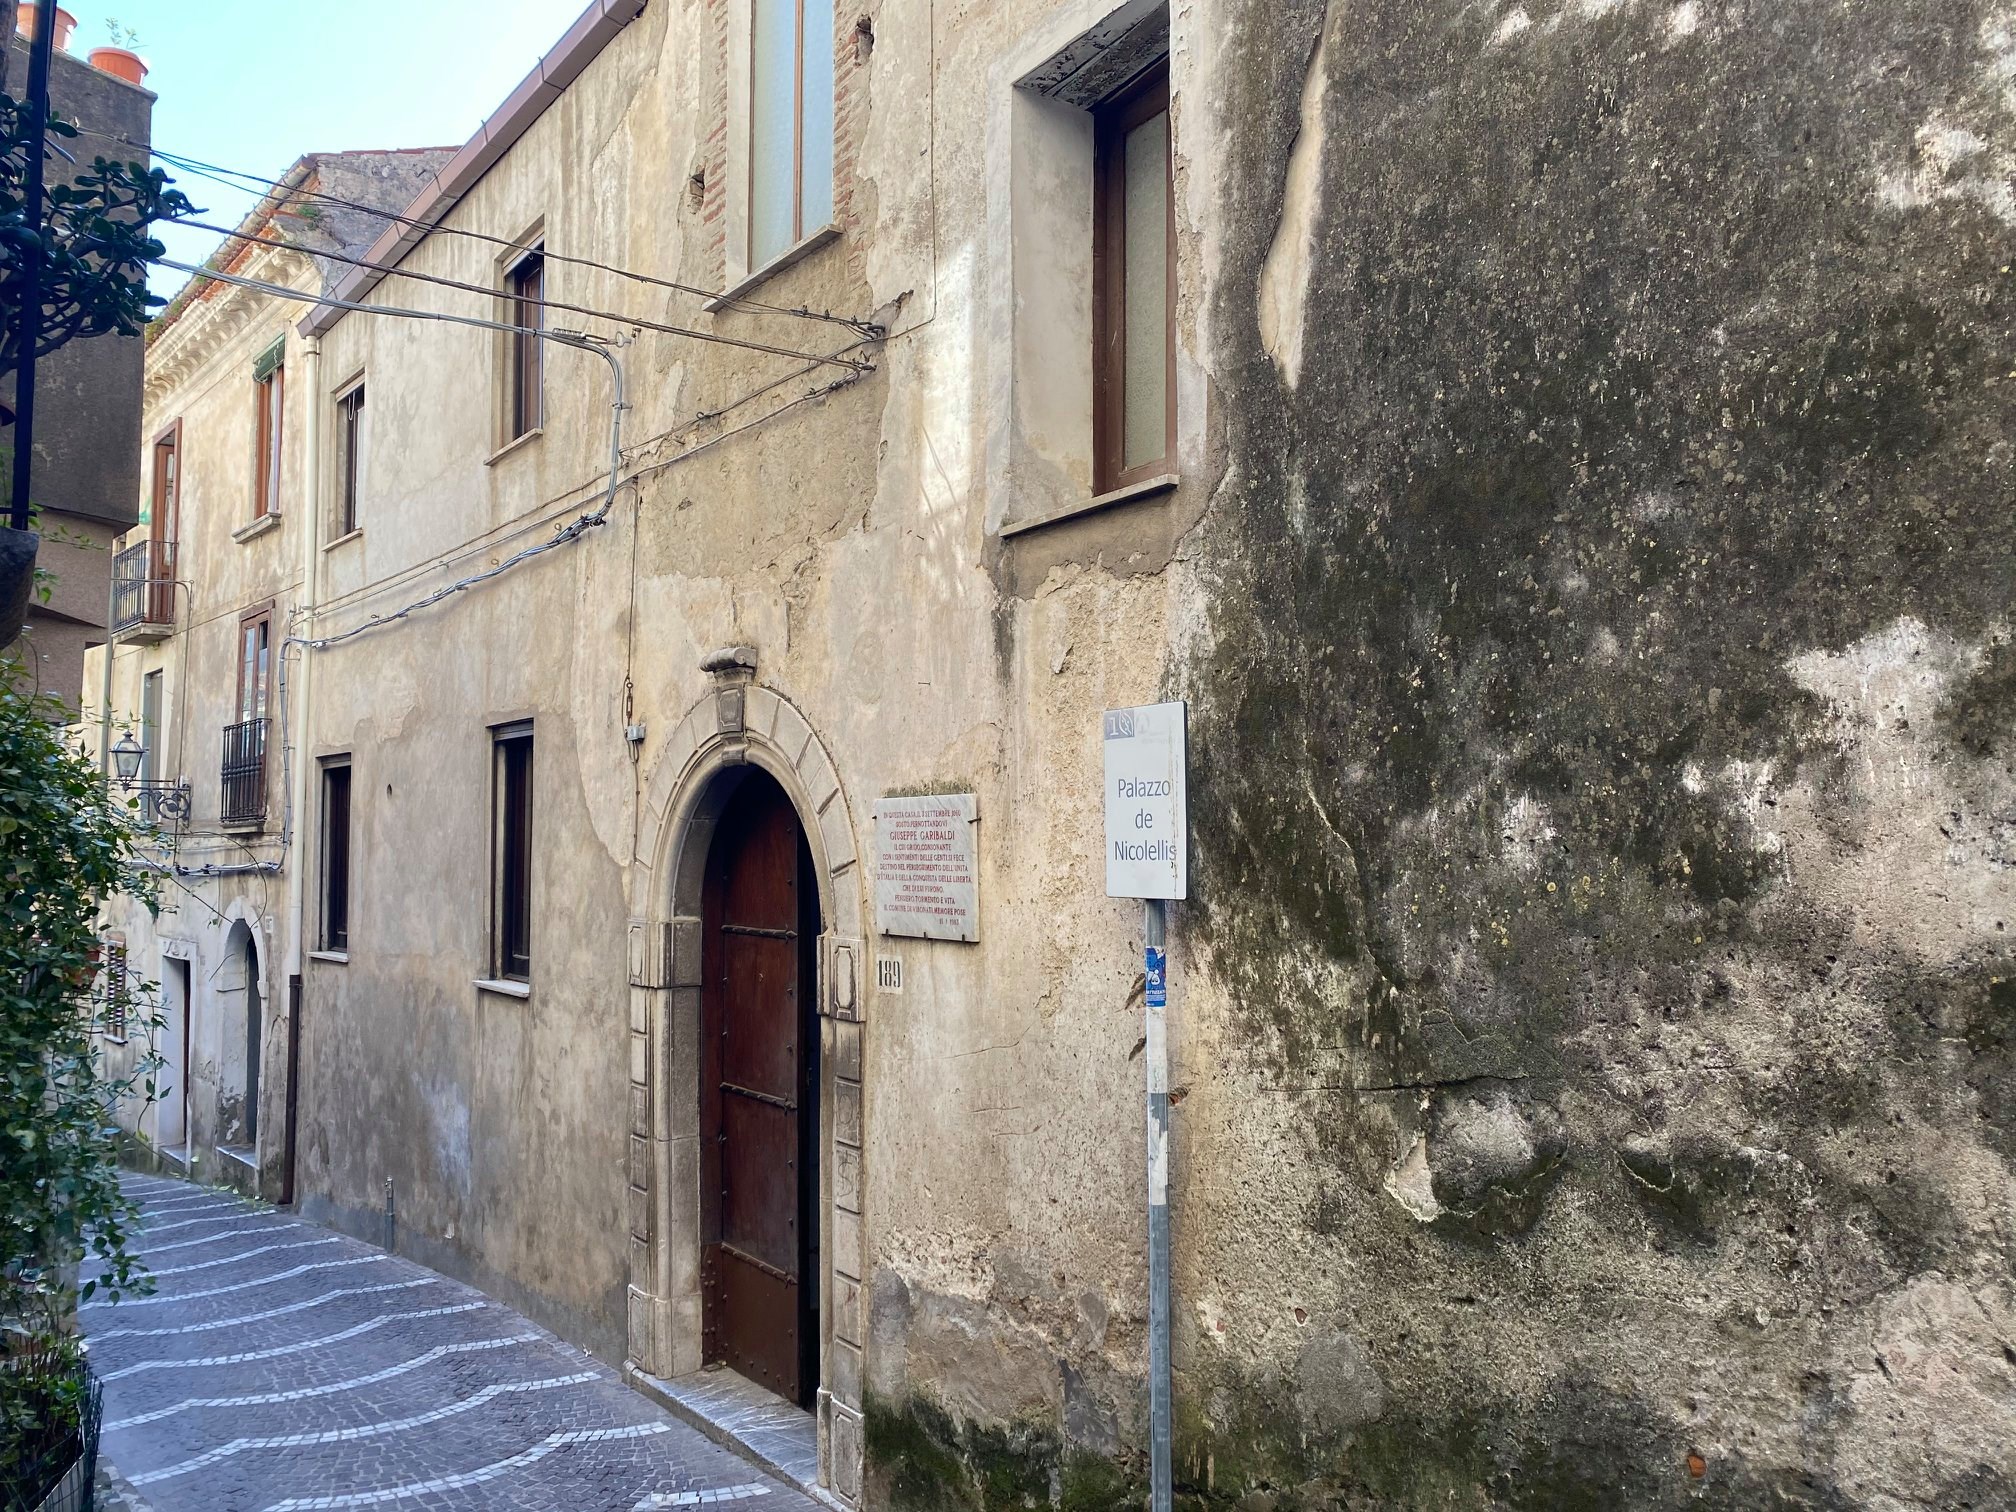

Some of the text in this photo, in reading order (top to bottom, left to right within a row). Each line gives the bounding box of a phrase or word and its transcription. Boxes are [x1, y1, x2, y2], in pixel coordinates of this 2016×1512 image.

[1118, 776, 1171, 798] Palazzo
[1135, 808, 1153, 829] de
[890, 830, 955, 841] GIUSEPPE GARIBALDI
[1114, 840, 1177, 861] Nicolellis
[920, 854, 933, 862] DELLE
[913, 874, 937, 882] CONQUISTA
[903, 884, 911, 892] CHE
[915, 895, 939, 904] TORMENTO
[945, 897, 956, 905] VITA
[889, 904, 906, 912] COMUNE
[933, 907, 953, 916] MEMORE
[954, 908, 966, 916] POSE
[879, 960, 900, 987] 189
